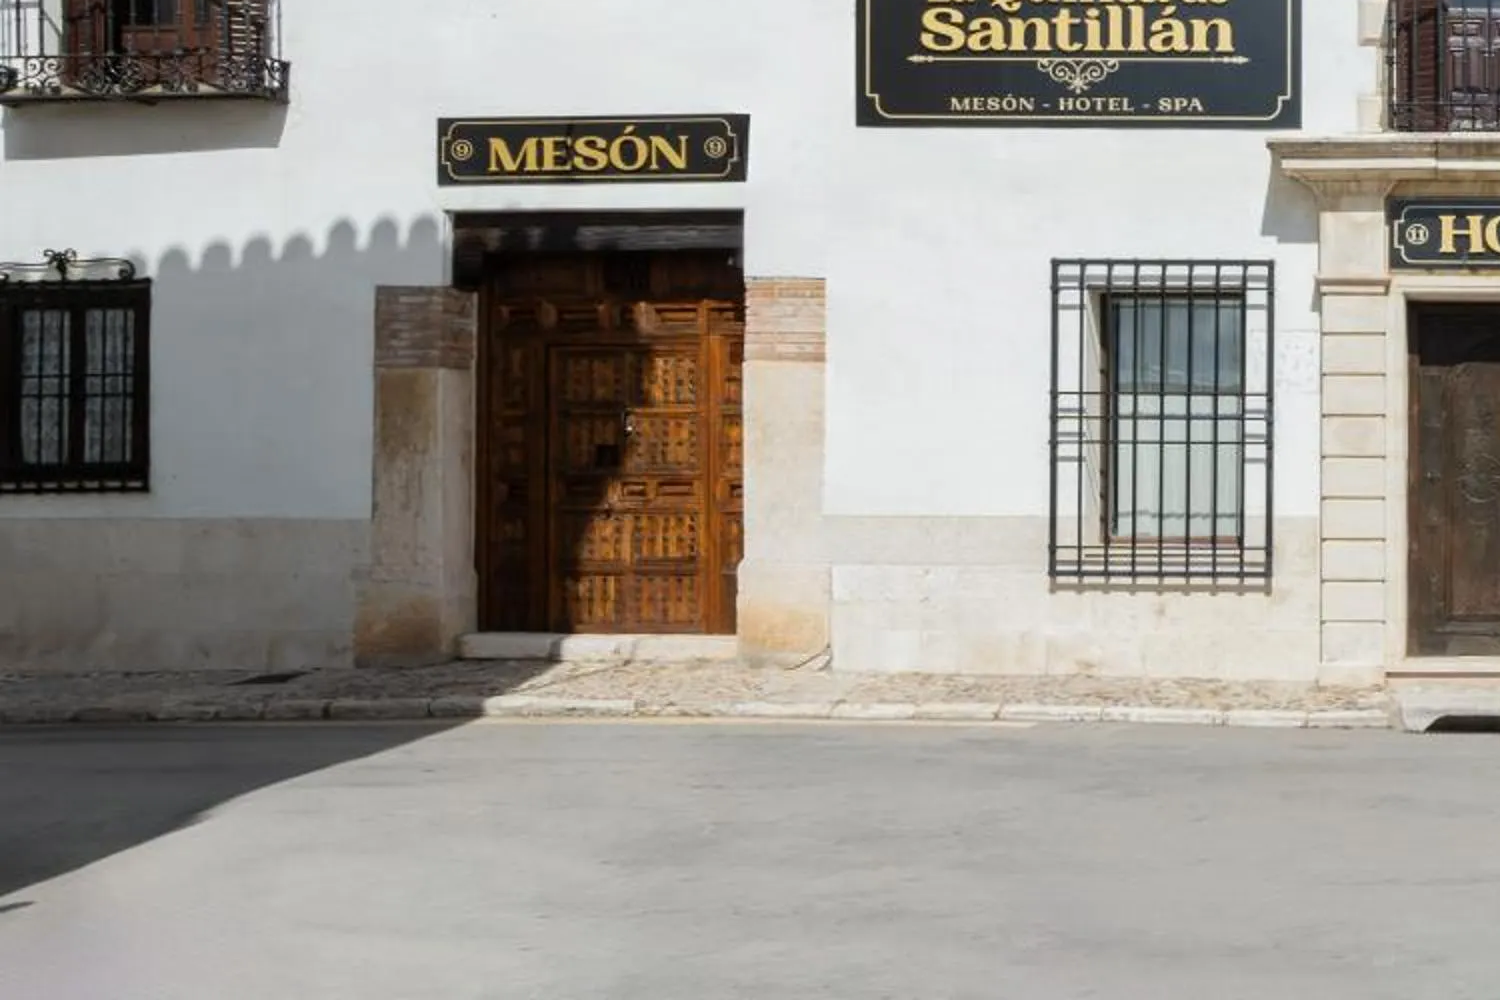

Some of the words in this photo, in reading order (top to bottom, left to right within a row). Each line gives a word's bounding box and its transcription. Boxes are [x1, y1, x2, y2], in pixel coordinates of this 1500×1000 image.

[920, 4, 1235, 53] Santillán
[950, 93, 1035, 111] MESÓN
[1058, 97, 1135, 112] HOTEL
[1158, 97, 1204, 113] SPA
[488, 125, 689, 172] MESÓN
